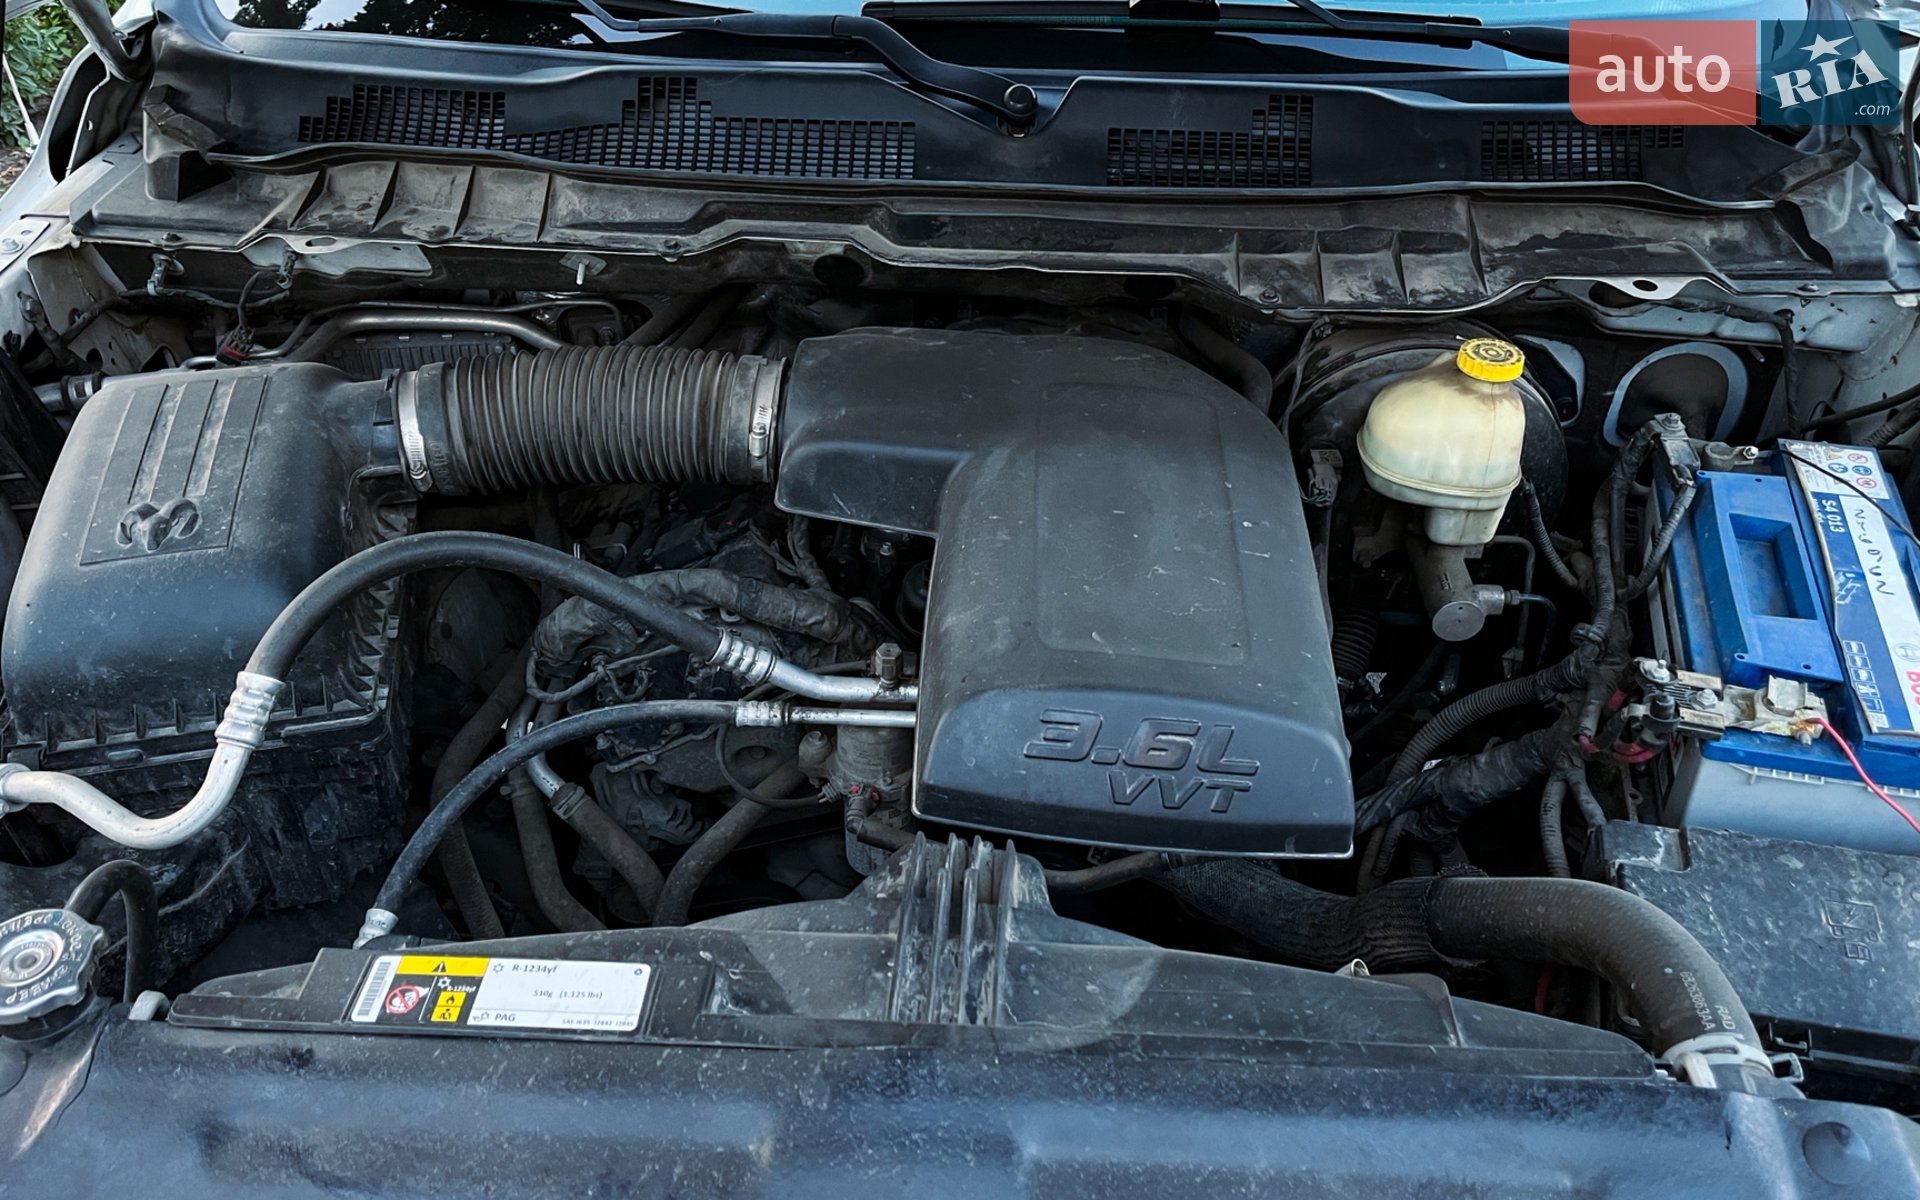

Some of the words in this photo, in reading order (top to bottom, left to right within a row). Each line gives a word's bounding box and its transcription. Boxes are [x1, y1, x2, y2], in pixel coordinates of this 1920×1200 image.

[1821, 499, 1838, 514] S4
[1826, 513, 1846, 534] 013
[1023, 707, 1261, 776] 3.6L
[1107, 769, 1253, 813] VVT
[511, 963, 558, 974] R-1234yf
[559, 990, 586, 999] (1.125
[587, 991, 603, 1000] lbs)
[494, 1013, 517, 1022] PAG
[1714, 1004, 1736, 1030] RAD
